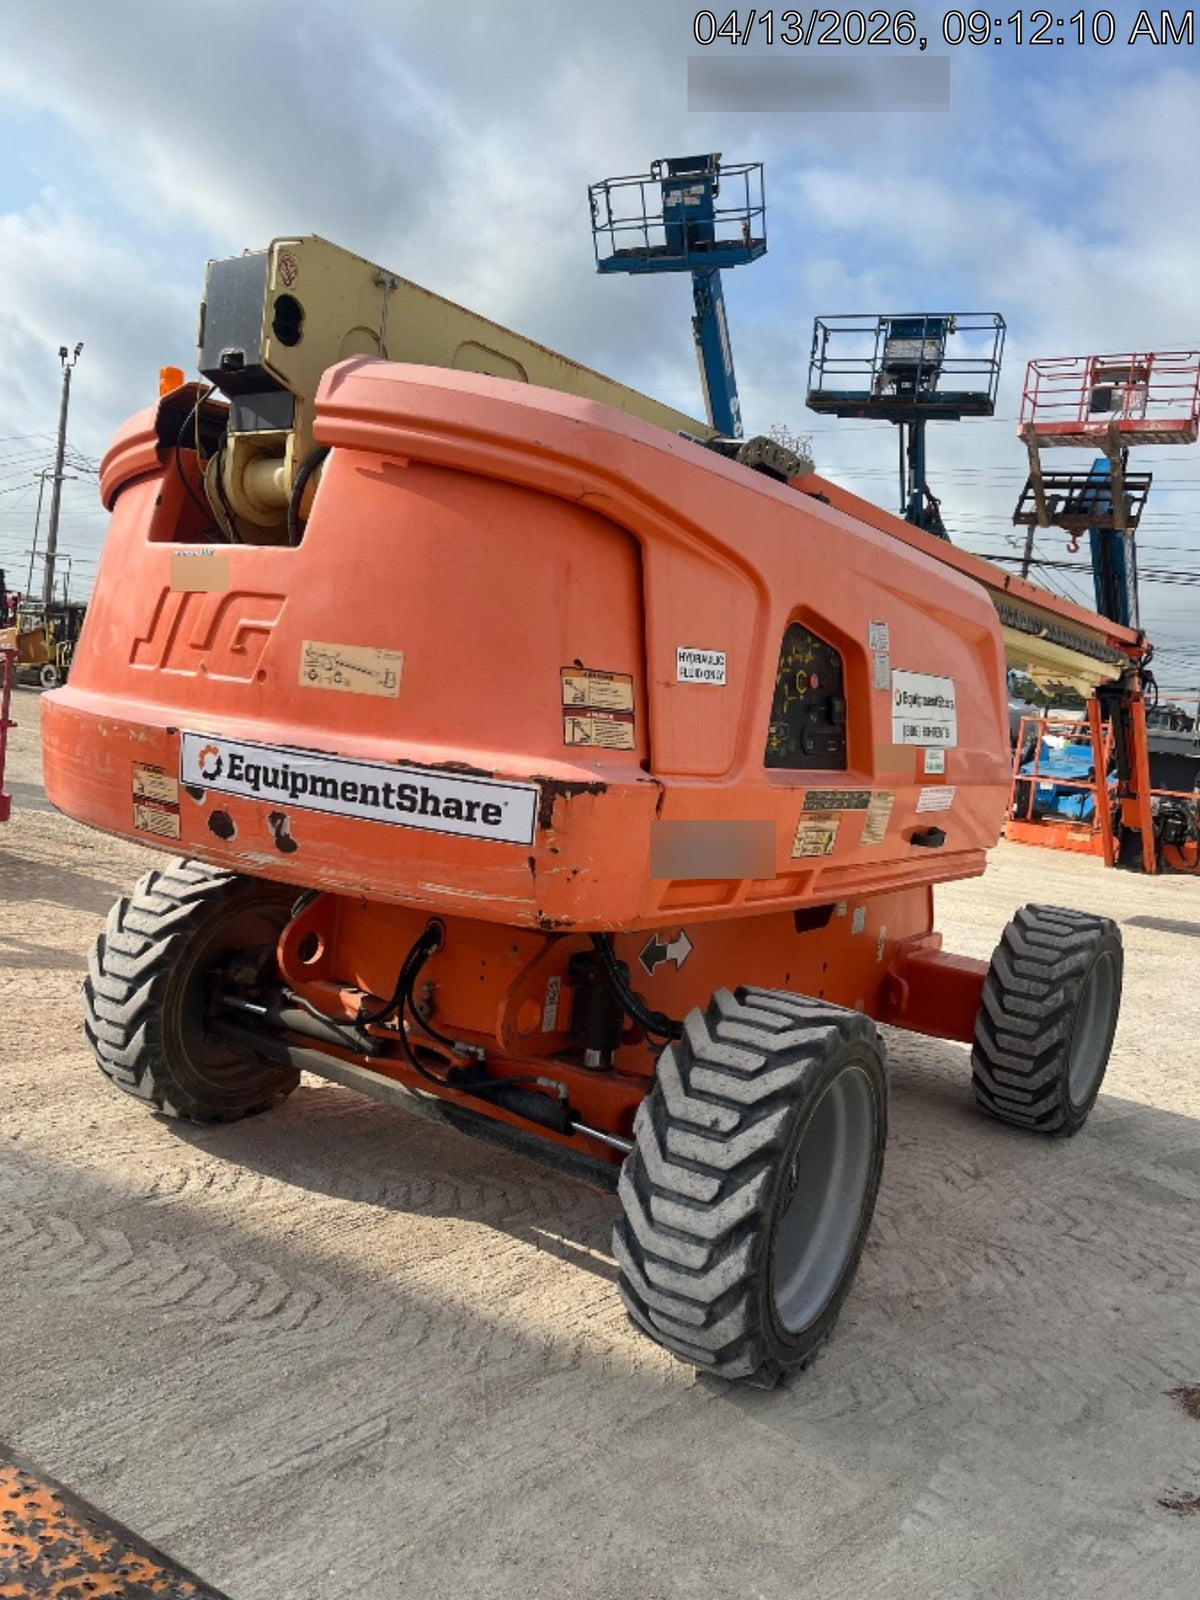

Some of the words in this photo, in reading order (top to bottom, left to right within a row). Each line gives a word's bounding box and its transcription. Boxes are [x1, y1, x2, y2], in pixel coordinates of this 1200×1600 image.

[129, 585, 289, 684] JLG
[678, 652, 725, 666] HYDRAULIC
[227, 752, 503, 826] EquipmentShare
